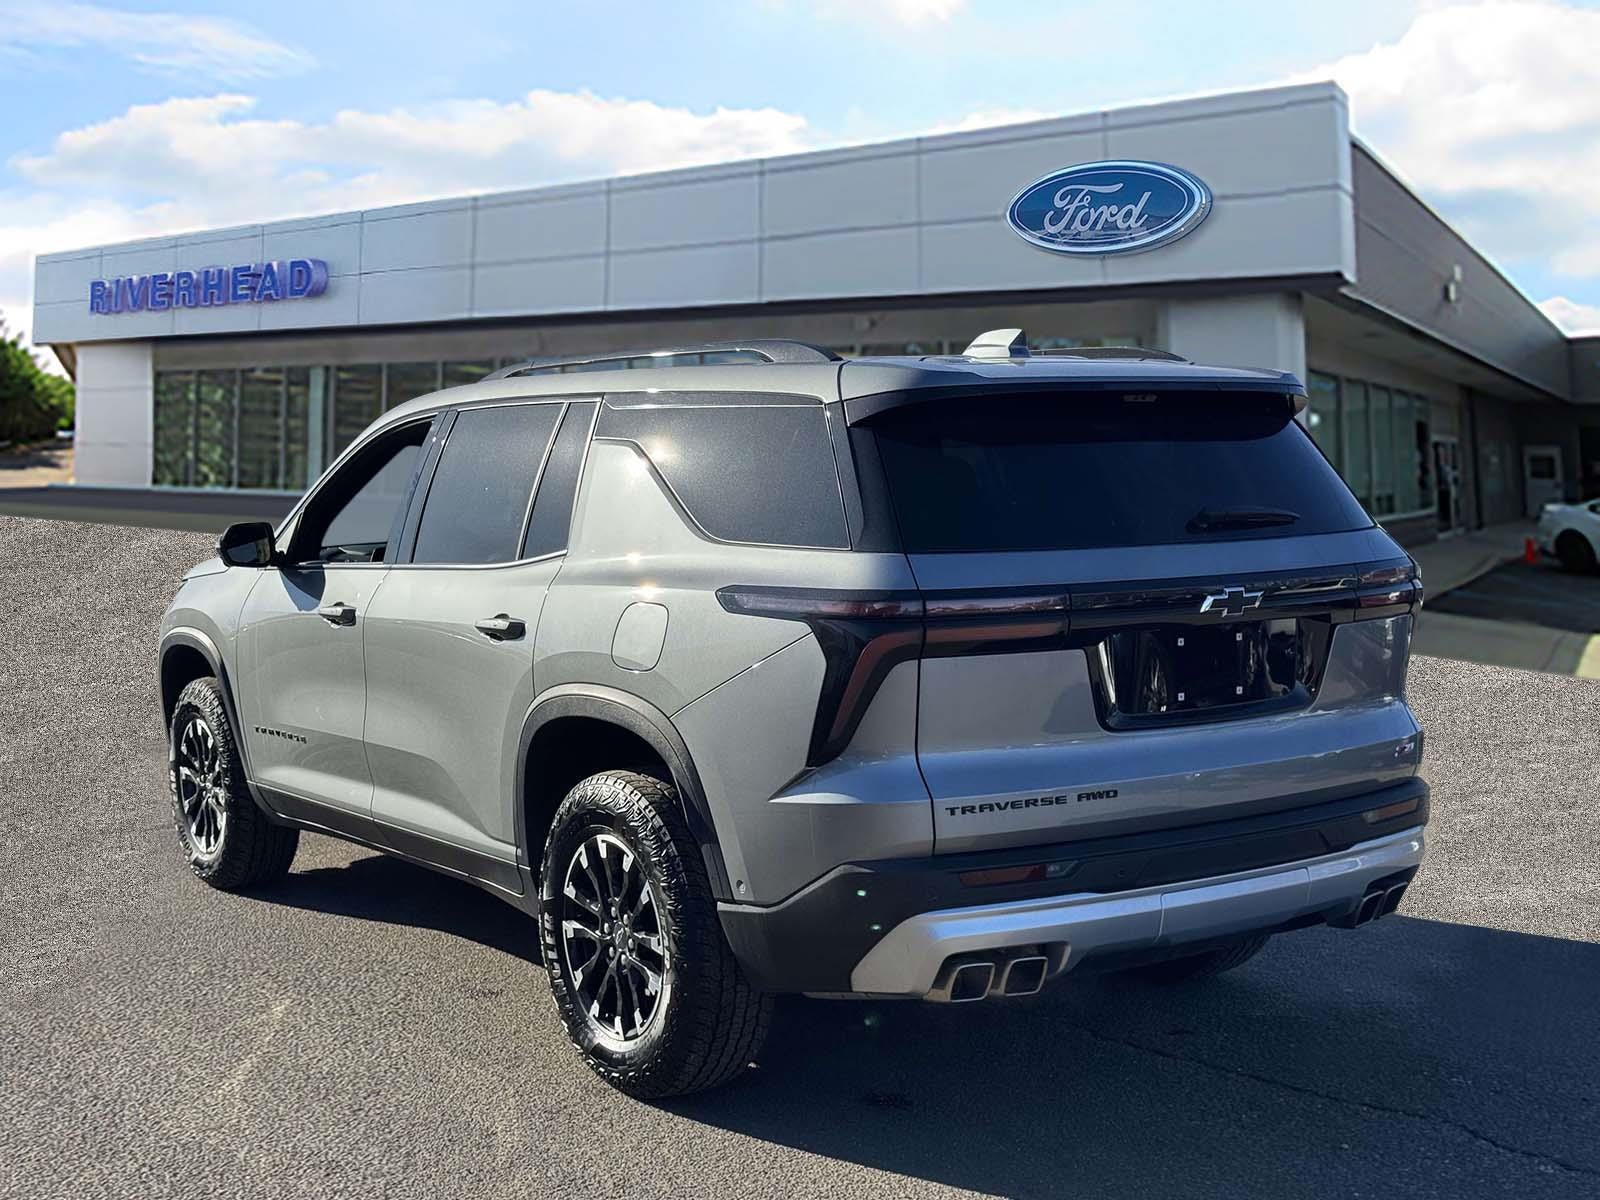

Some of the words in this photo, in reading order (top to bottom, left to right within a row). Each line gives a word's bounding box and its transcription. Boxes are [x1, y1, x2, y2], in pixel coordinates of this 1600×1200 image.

[1043, 183, 1152, 233] Ford
[89, 258, 328, 315] RIVERHEAD
[945, 798, 1067, 816] TRAVERSE
[1077, 789, 1118, 803] AWD
